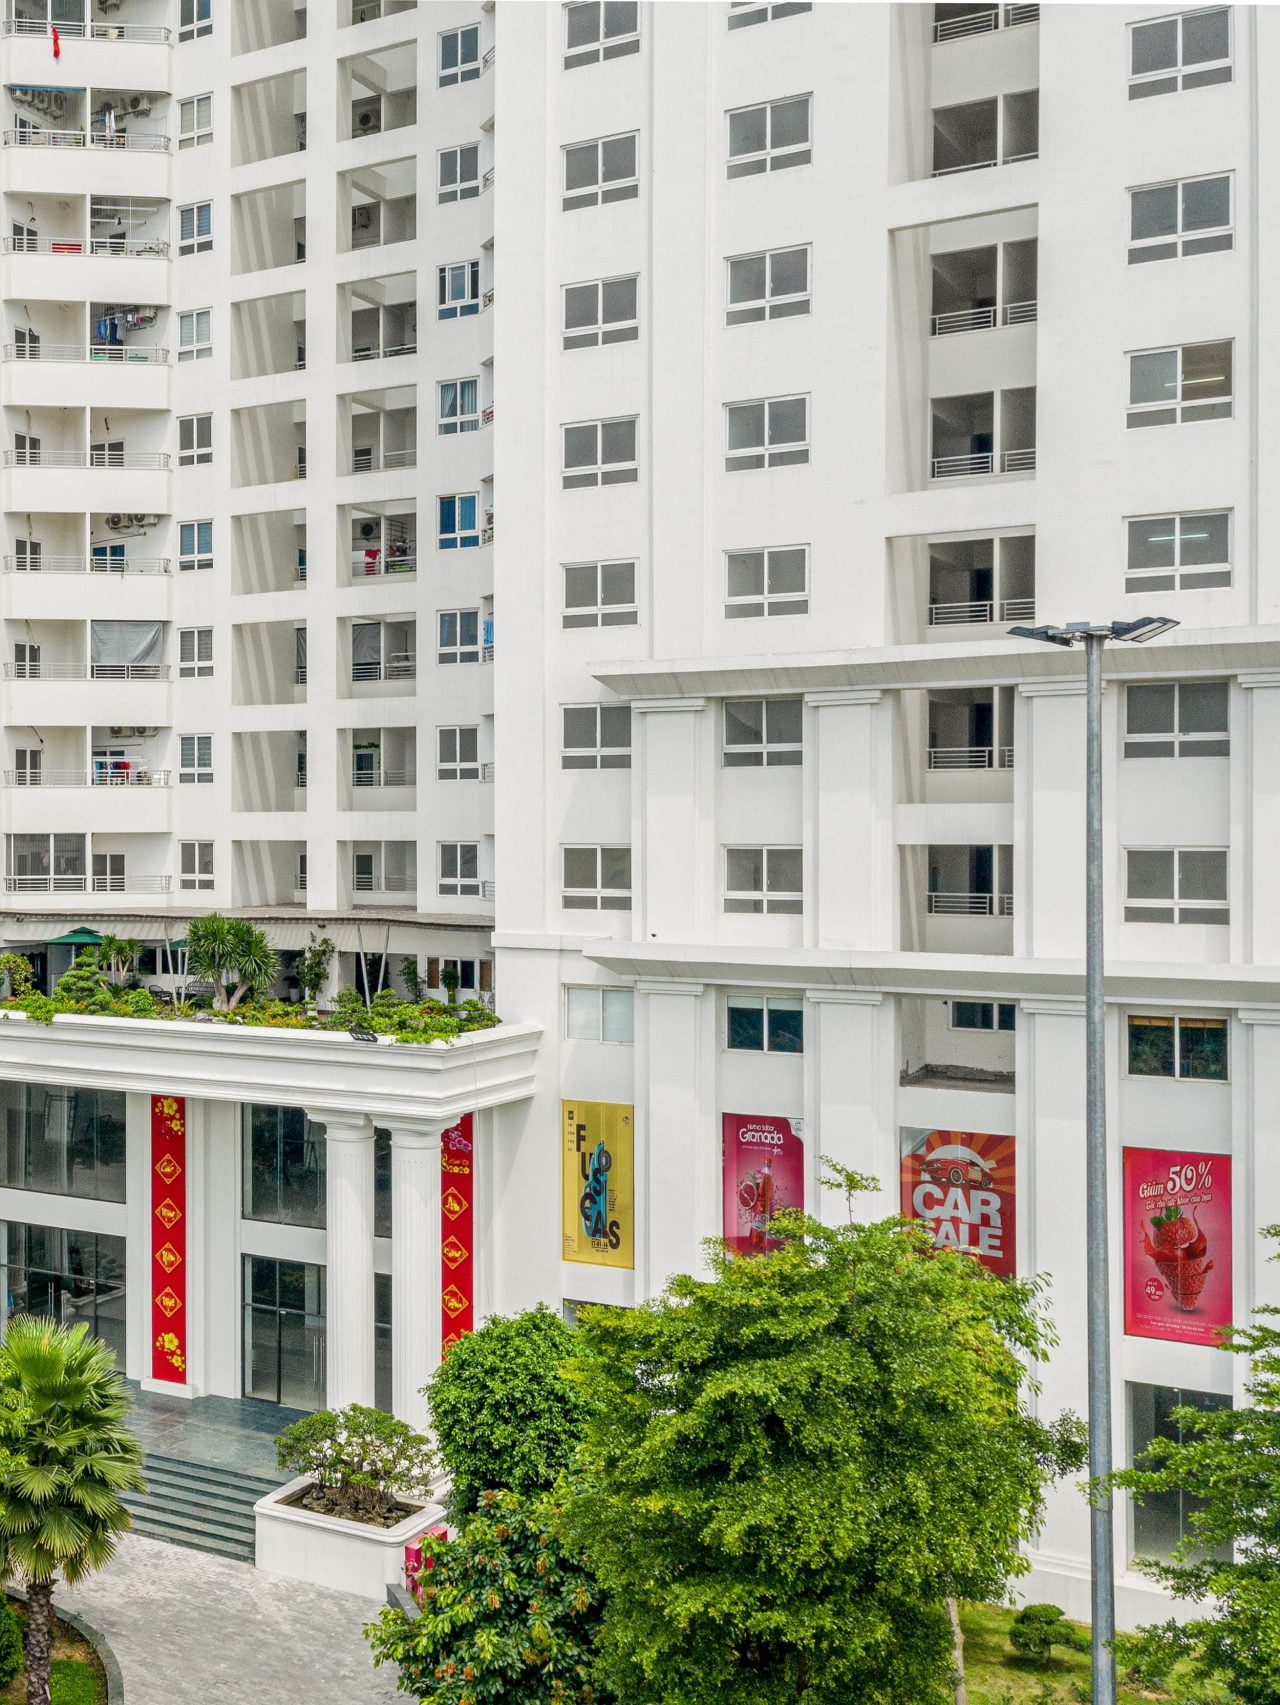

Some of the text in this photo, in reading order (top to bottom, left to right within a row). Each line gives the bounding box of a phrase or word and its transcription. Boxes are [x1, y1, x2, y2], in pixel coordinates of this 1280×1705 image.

[739, 1128, 784, 1145] Granada
[1167, 1161, 1212, 1194] 50%
[912, 1183, 1002, 1228] CAR
